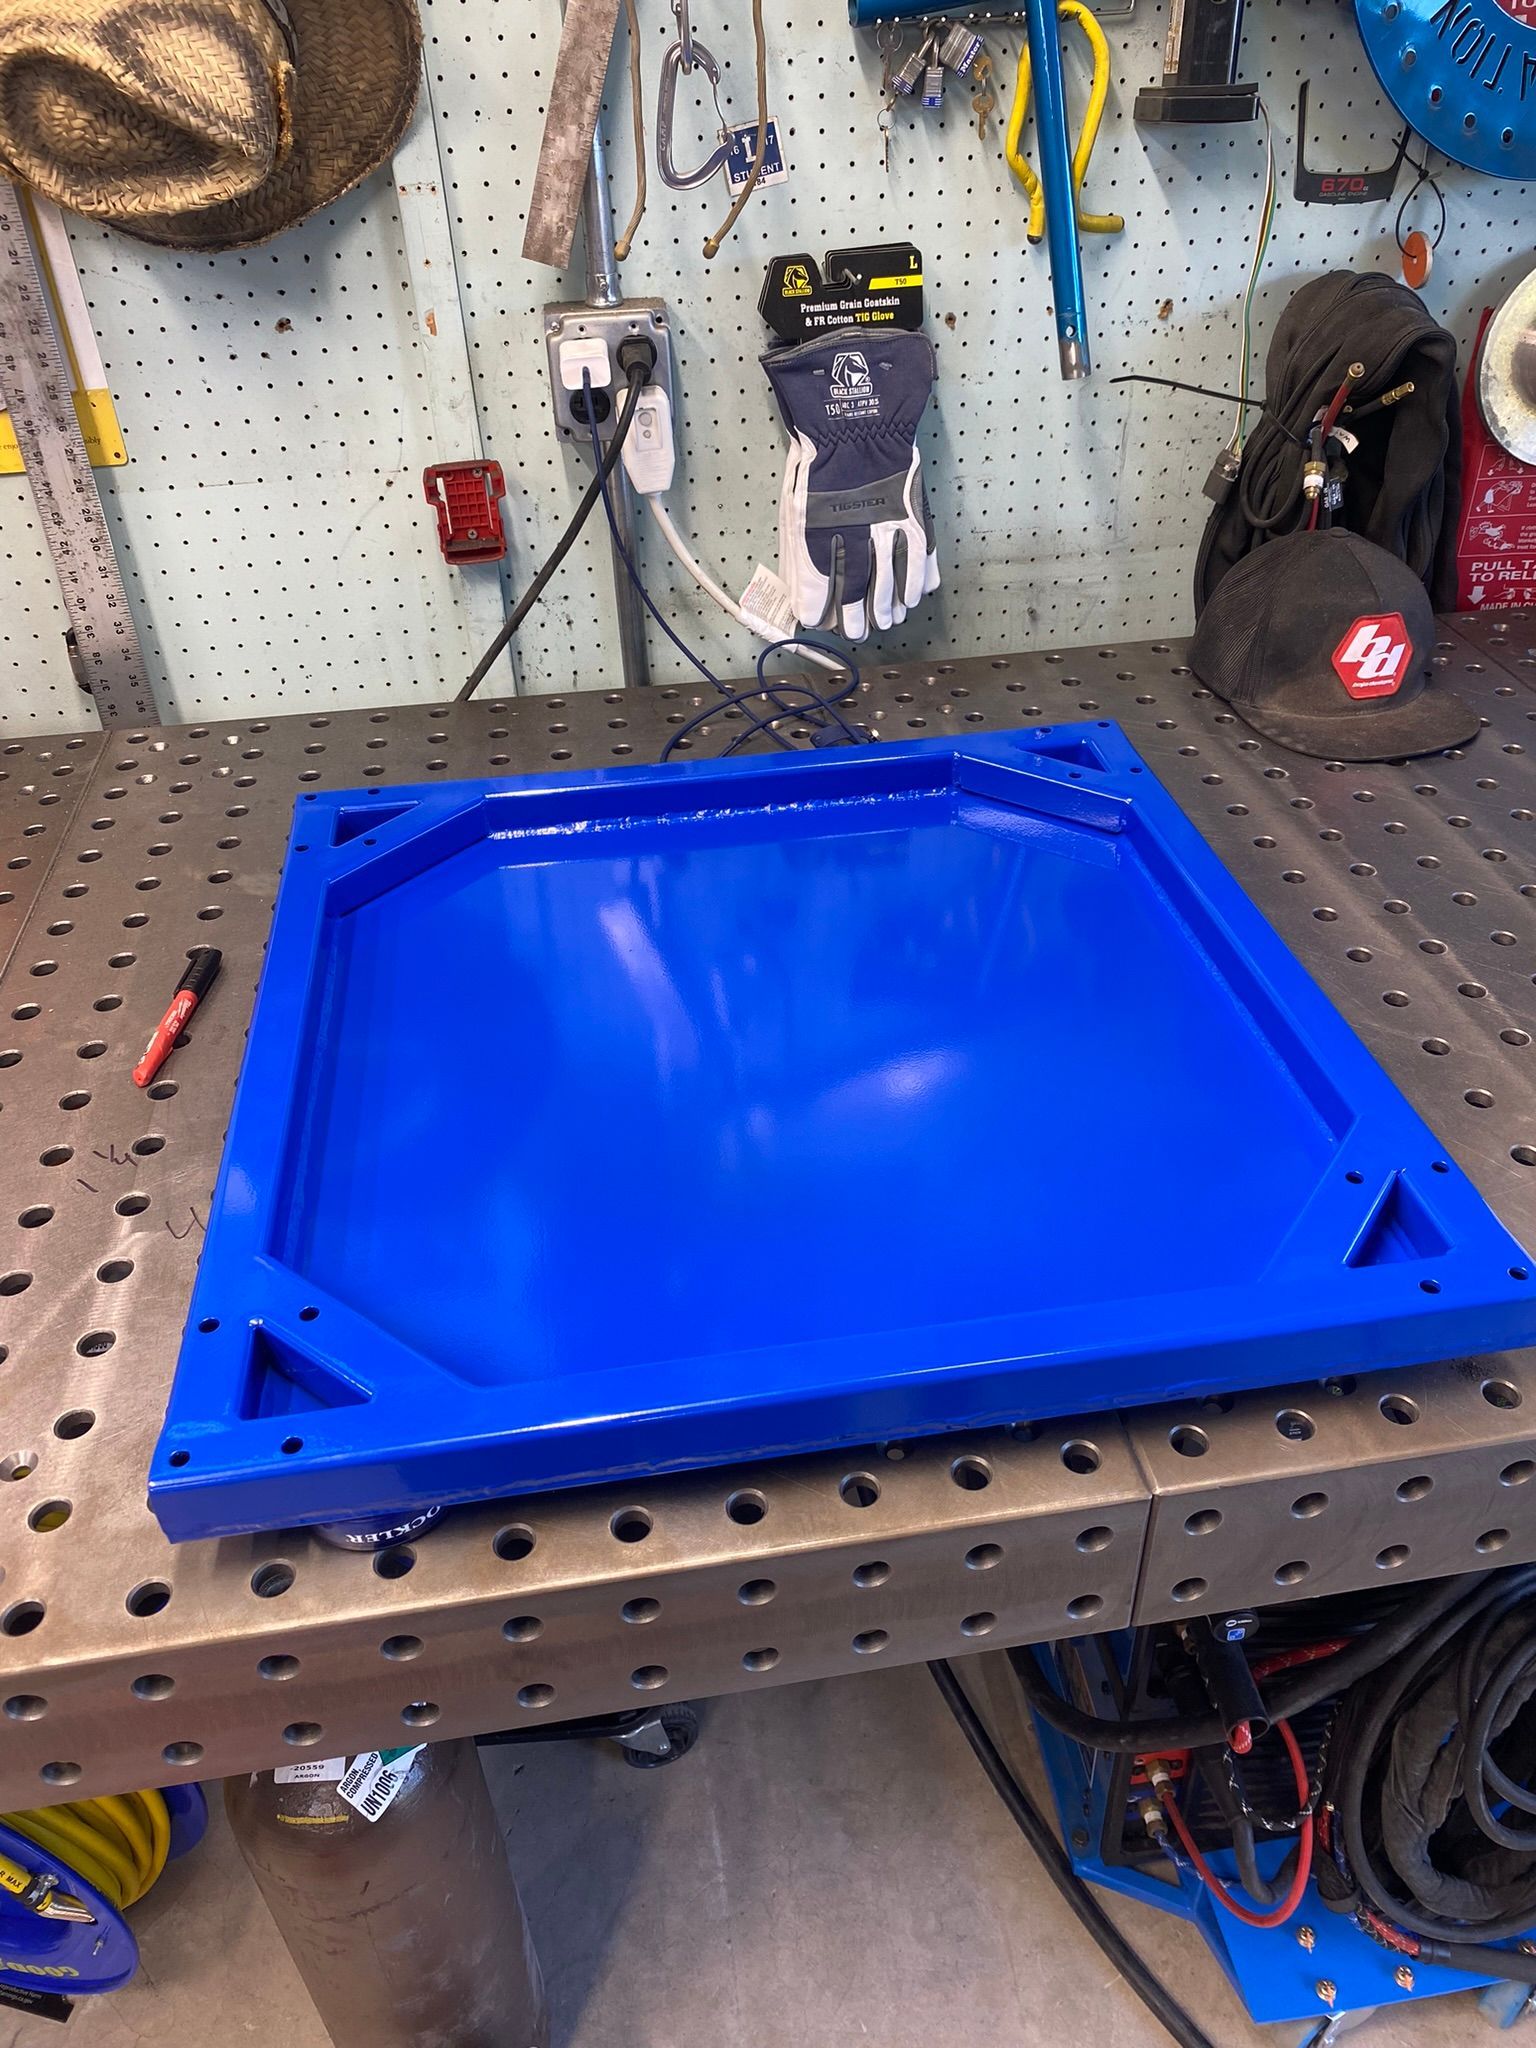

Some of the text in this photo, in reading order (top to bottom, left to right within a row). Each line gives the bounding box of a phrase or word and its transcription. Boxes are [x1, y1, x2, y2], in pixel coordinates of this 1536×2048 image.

[960, 42, 981, 73] Master
[733, 162, 780, 182] STENT
[1321, 177, 1366, 192] 670
[909, 255, 918, 269] L
[894, 278, 907, 286] T50
[800, 296, 900, 313] Premium Grain Goatskin
[805, 311, 895, 327] & FR Cotton TIG Glove
[5, 355, 16, 371] 48
[15, 388, 25, 404] 47
[833, 386, 870, 395] BLACK STALLION
[825, 403, 840, 416] T50
[8, 250, 20, 266] 21
[18, 285, 30, 301] 22
[28, 319, 40, 335] 23
[38, 353, 49, 368] 24
[47, 385, 58, 400] 25
[56, 417, 67, 432] 26
[65, 448, 76, 463] 27
[73, 479, 85, 493] 28
[82, 508, 93, 523] 29
[90, 537, 100, 551] 30
[98, 566, 109, 579] 31
[106, 594, 116, 608] 32
[114, 622, 124, 635] 33
[121, 648, 132, 661] 34
[129, 674, 139, 687] 35
[136, 700, 146, 713] 36
[830, 498, 886, 512] TIGSTER
[60, 541, 70, 555] 42
[1471, 560, 1516, 572] PULL
[68, 571, 79, 584] 41
[1469, 572, 1494, 582] TO
[77, 598, 87, 611] 40
[1480, 601, 1509, 611] MADE
[1510, 601, 1522, 609] IN
[85, 625, 95, 639] 39
[93, 652, 103, 665] 38
[100, 679, 111, 692] 37
[108, 704, 118, 717] 36
[340, 1767, 362, 1793] ARGON,
[346, 1752, 378, 1799] COMPRESSED
[360, 1769, 398, 1817] UN1006
[6, 1875, 23, 1889] MAX
